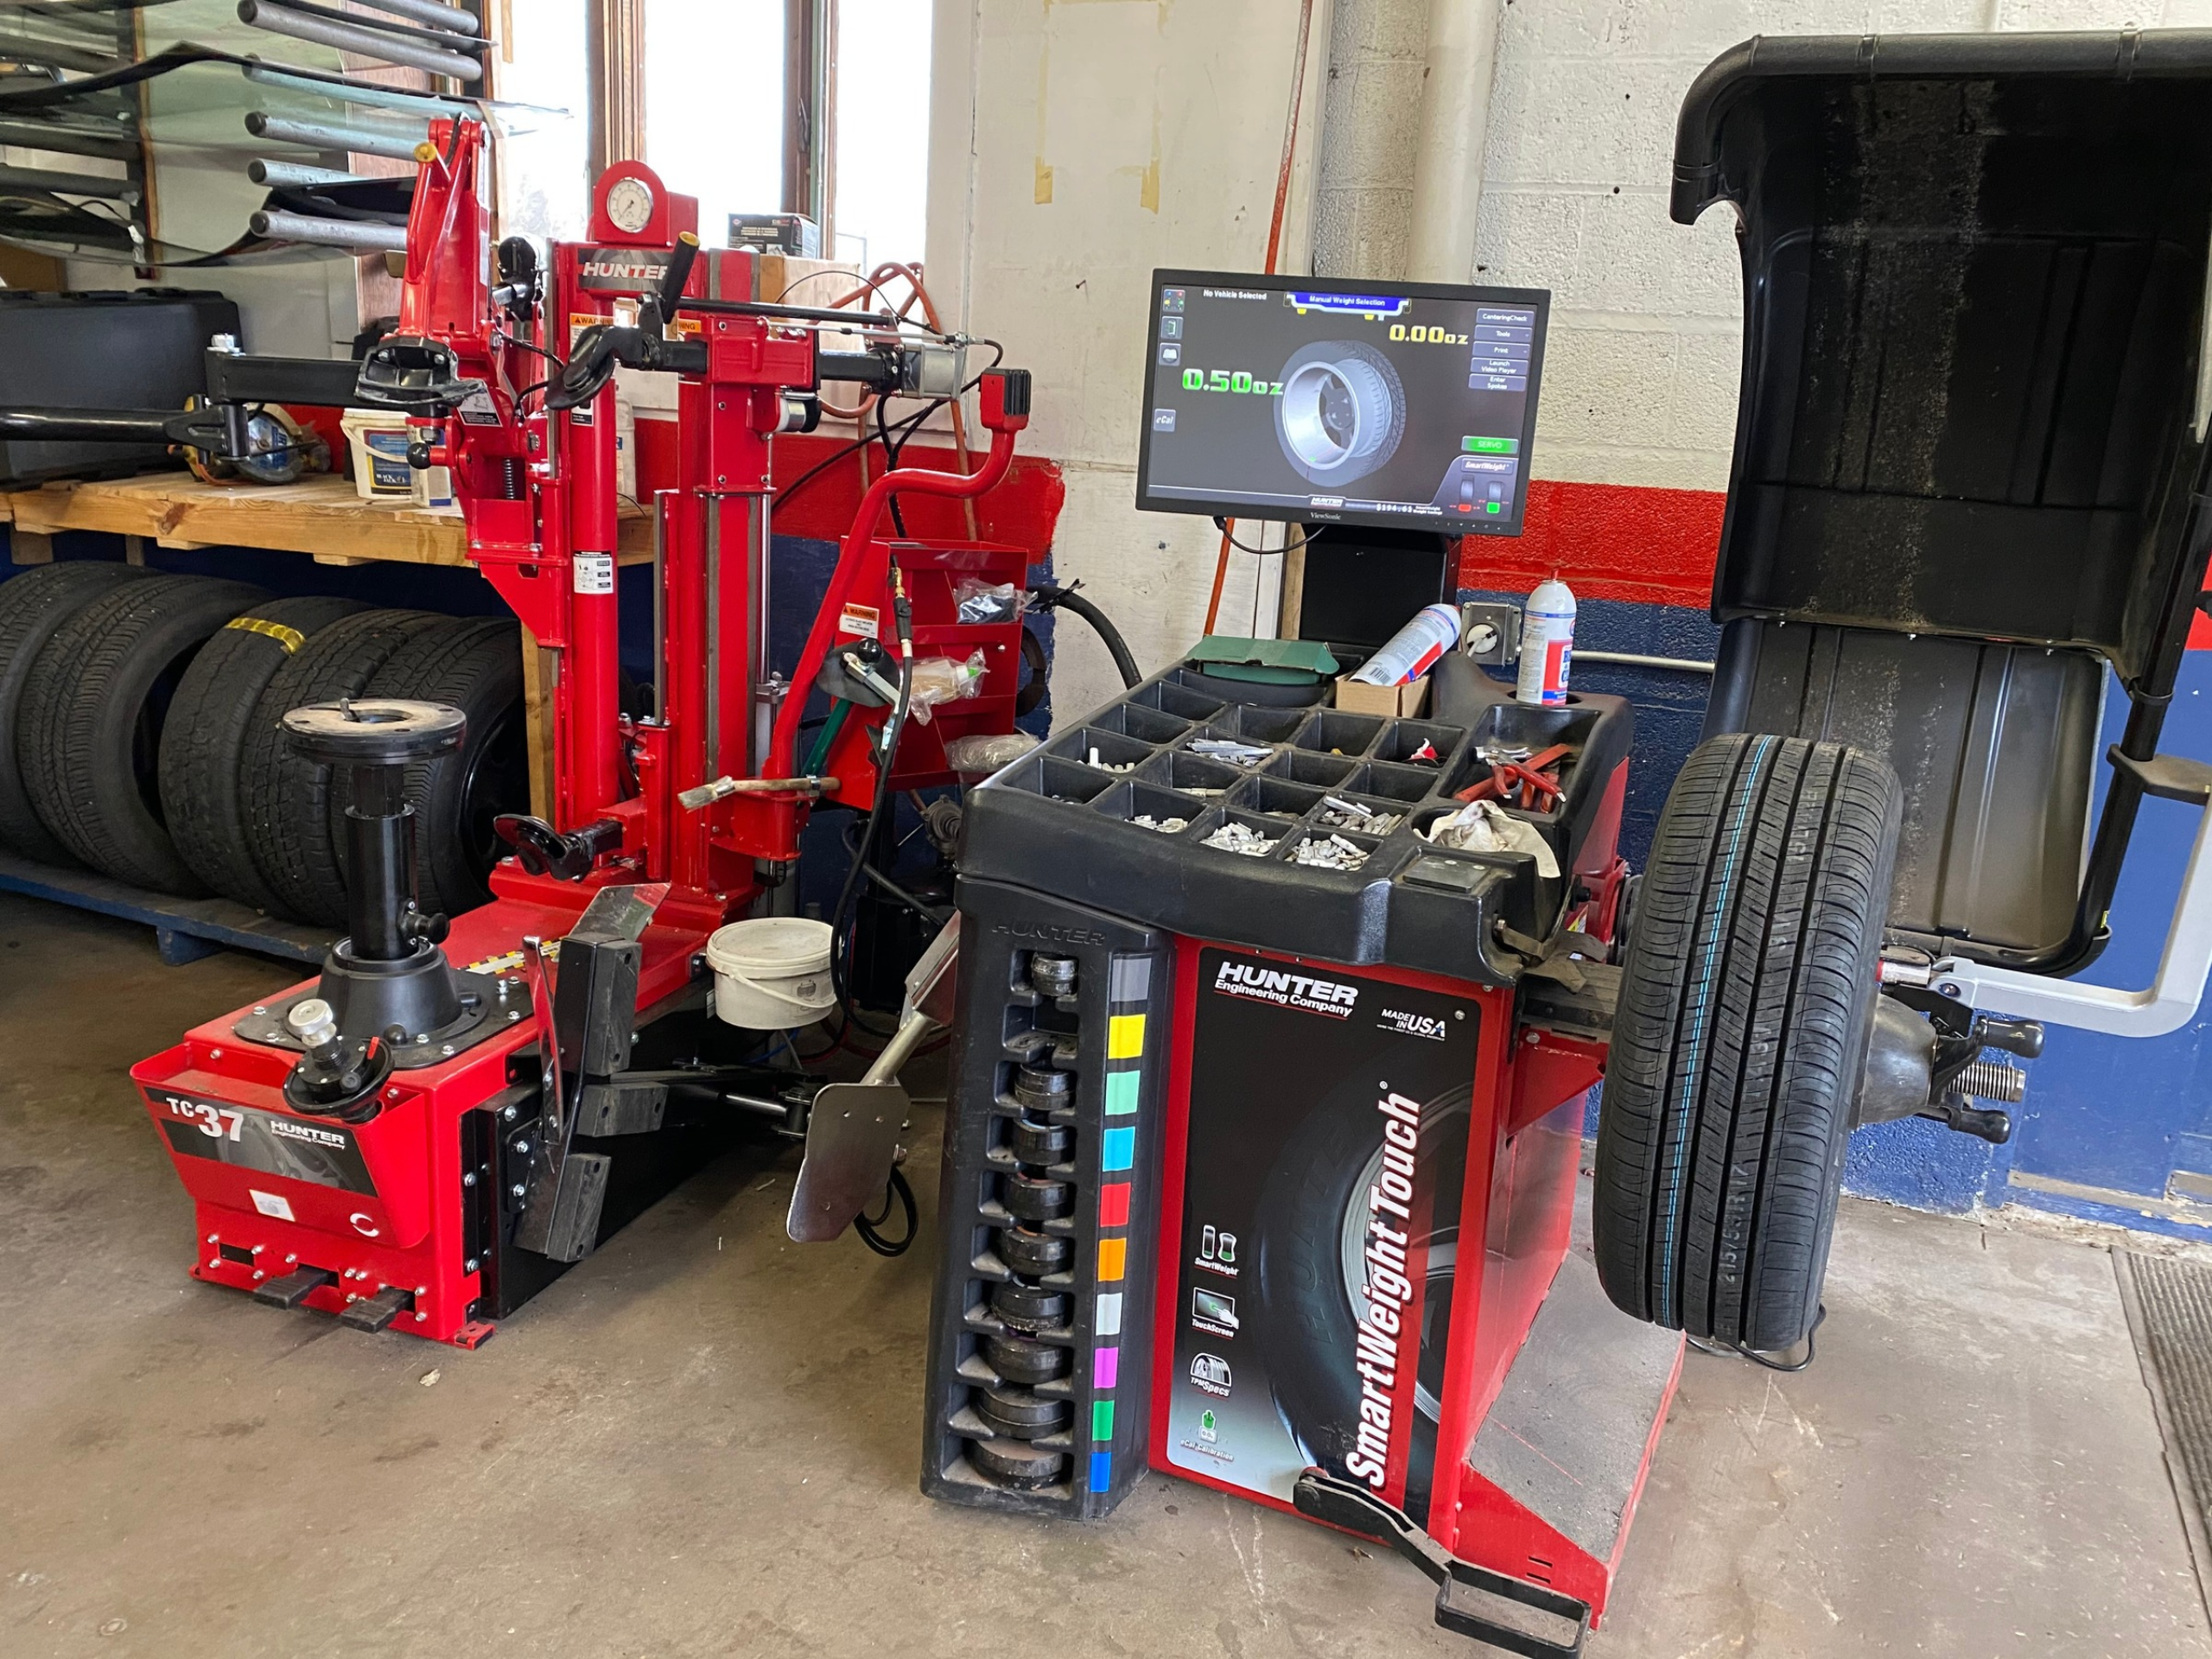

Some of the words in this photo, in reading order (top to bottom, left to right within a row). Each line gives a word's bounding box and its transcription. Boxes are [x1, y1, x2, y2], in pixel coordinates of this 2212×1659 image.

[1214, 289, 1236, 299] Vehicle
[1238, 291, 1267, 300] Selected
[1333, 297, 1355, 307] Weight
[1310, 512, 1341, 520] ViewSonic
[1217, 962, 1358, 1006] HUNTER
[1215, 979, 1288, 1004] Engineering
[1290, 995, 1353, 1018] Company
[1382, 1008, 1411, 1021] MADE
[1396, 1020, 1408, 1029] IN
[270, 1121, 345, 1145] HUNTER
[1370, 1093, 1420, 1220] Touch
[1194, 1257, 1238, 1276] SmartWeight
[1192, 1319, 1234, 1338] TouchScreen
[1345, 1217, 1412, 1488] SmartWeight
[1191, 1376, 1230, 1397] TPMSpecs
[1198, 1443, 1234, 1461] Calibration
